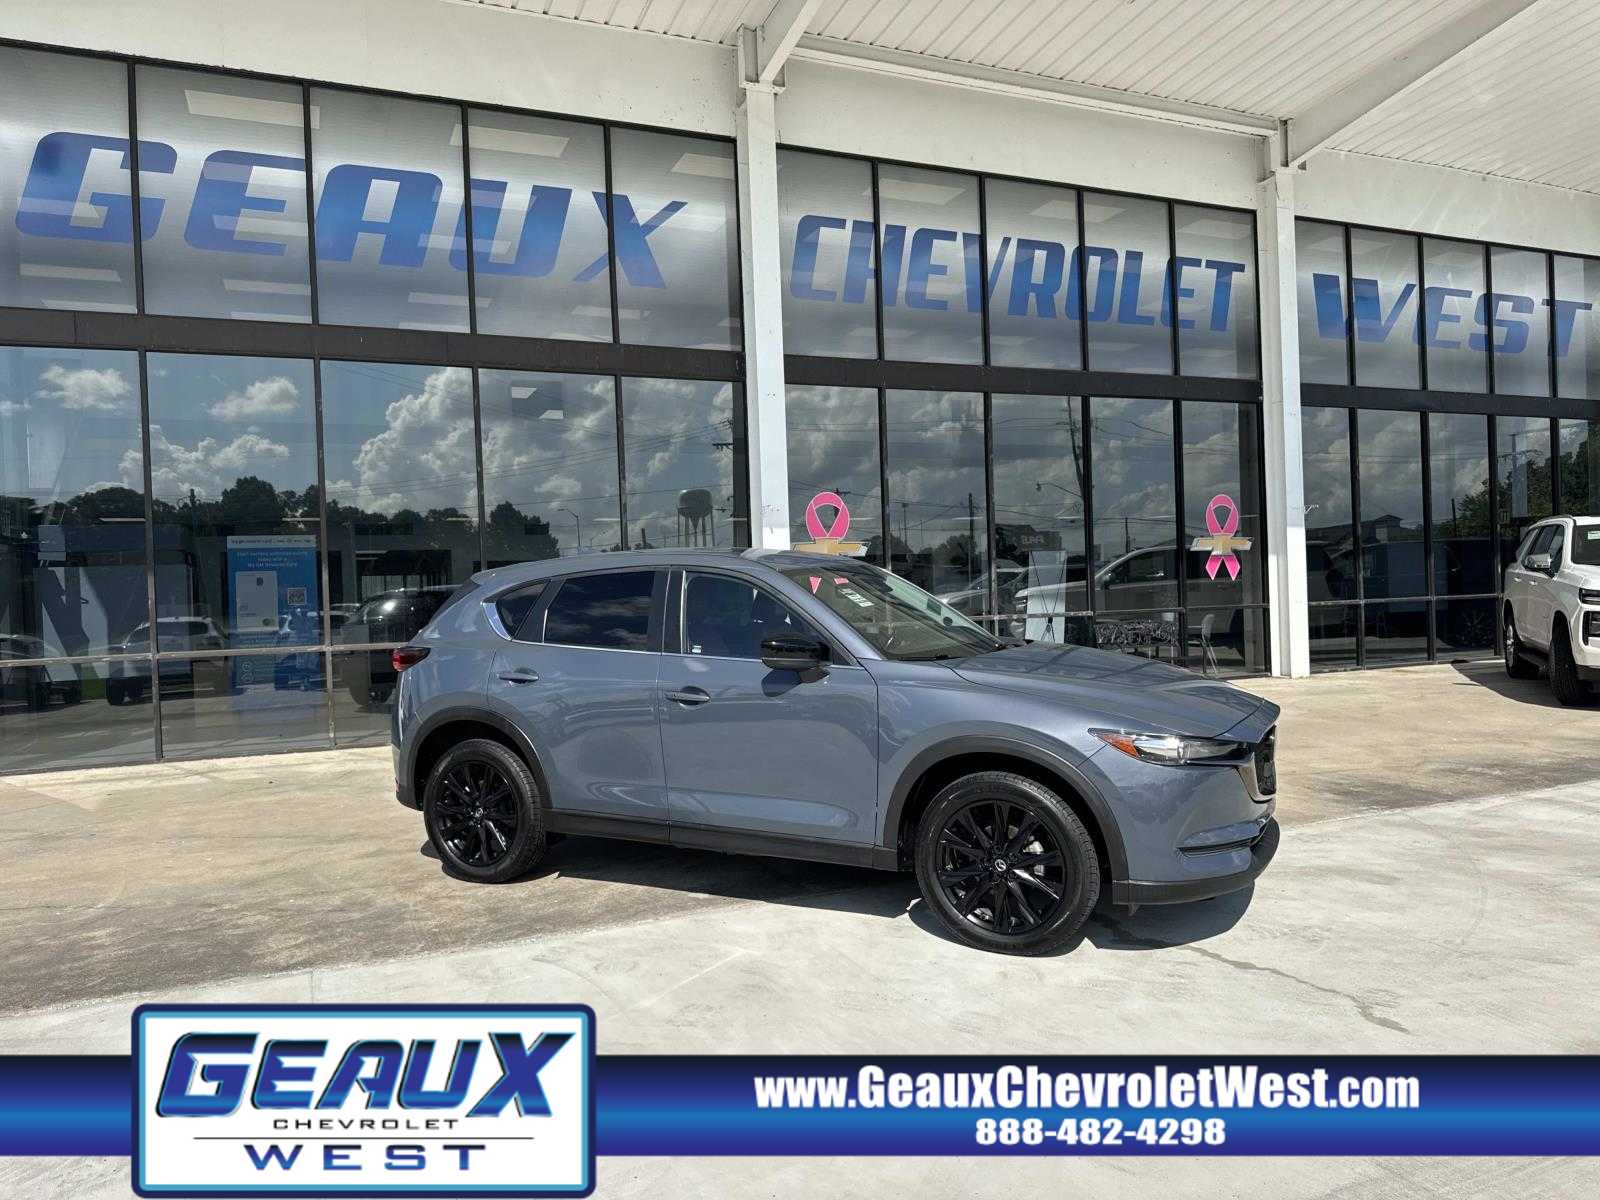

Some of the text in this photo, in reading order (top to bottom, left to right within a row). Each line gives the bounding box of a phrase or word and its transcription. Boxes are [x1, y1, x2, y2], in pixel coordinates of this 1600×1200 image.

[15, 131, 1593, 357] GEAUX CHEVROLET WEST
